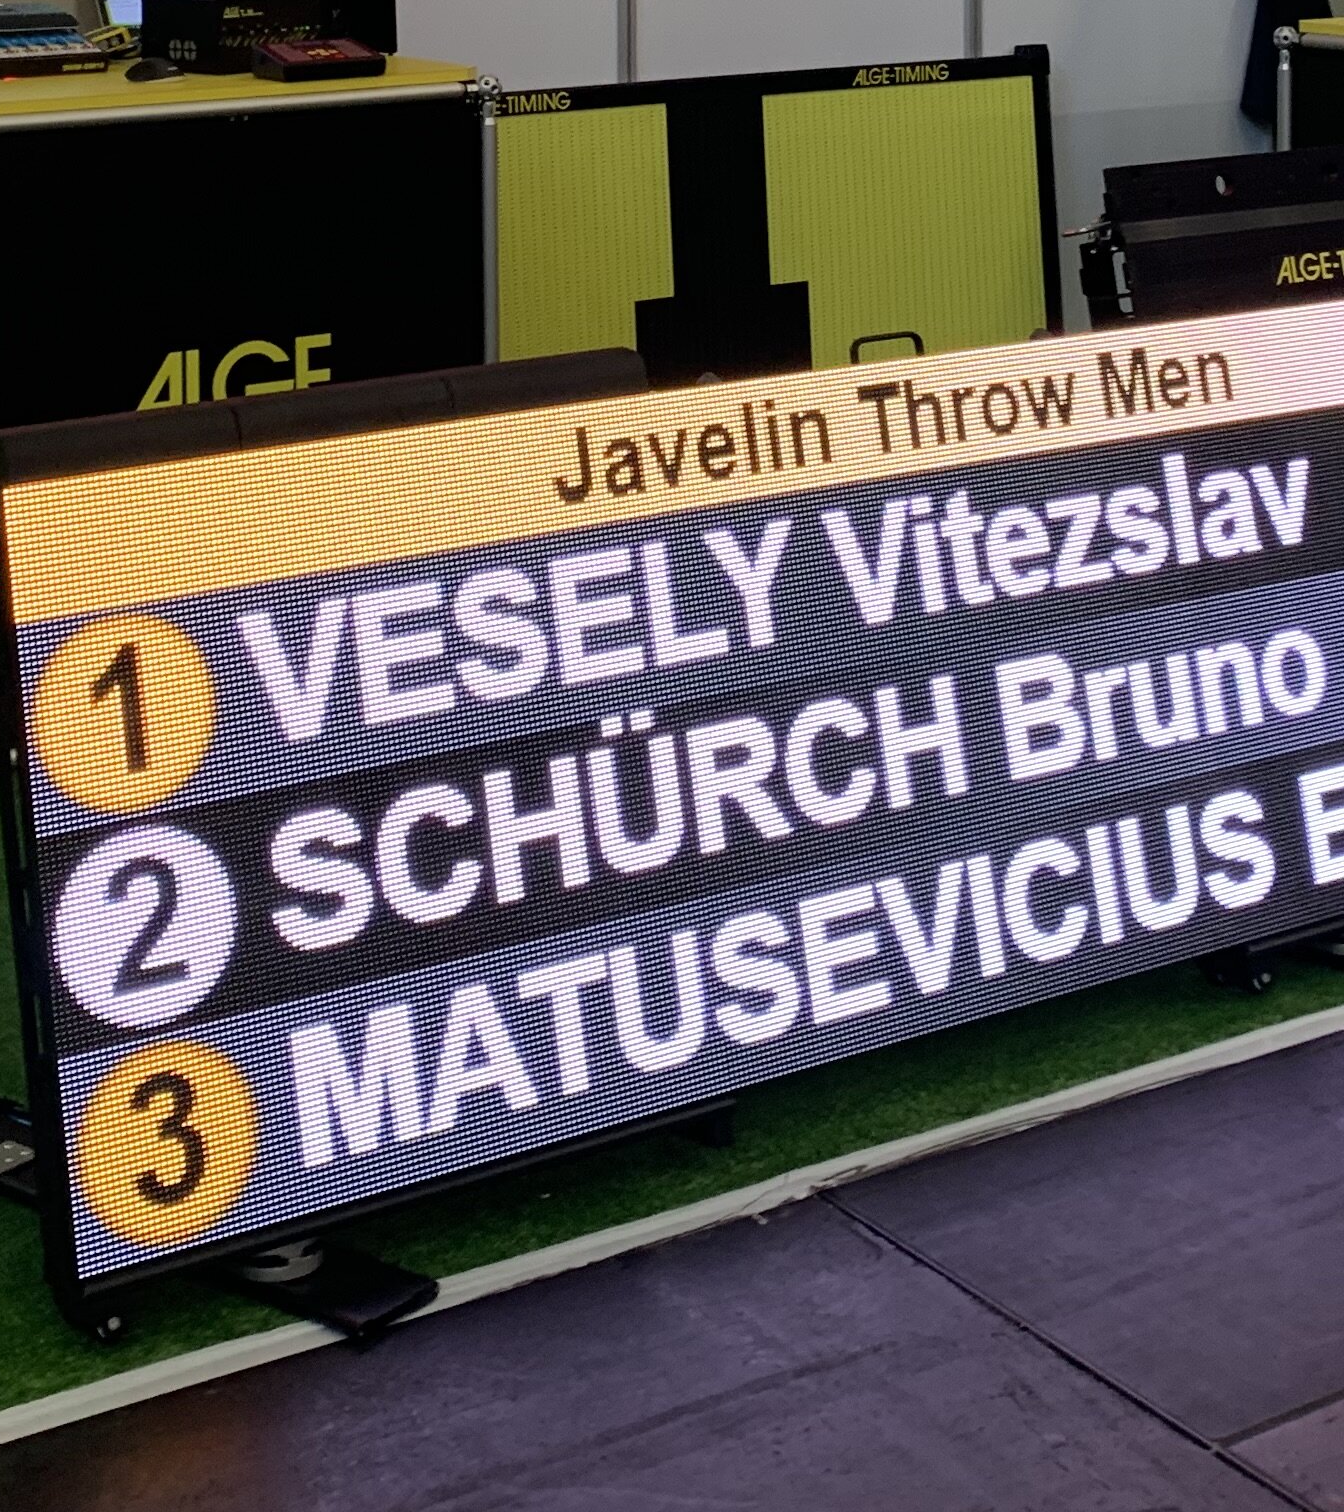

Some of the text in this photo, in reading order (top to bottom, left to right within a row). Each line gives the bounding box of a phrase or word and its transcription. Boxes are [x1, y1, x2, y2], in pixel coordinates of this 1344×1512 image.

[853, 64, 950, 87] ALGE-TIMING
[554, 347, 1235, 504] Javelin Throw Men
[90, 454, 1312, 775] 1 VESELY Vitezslav
[106, 628, 1327, 999] 2 SCHÜRCH Bruno
[130, 1070, 207, 1206] 3
[286, 790, 1278, 1170] MATUSEVICIUS
